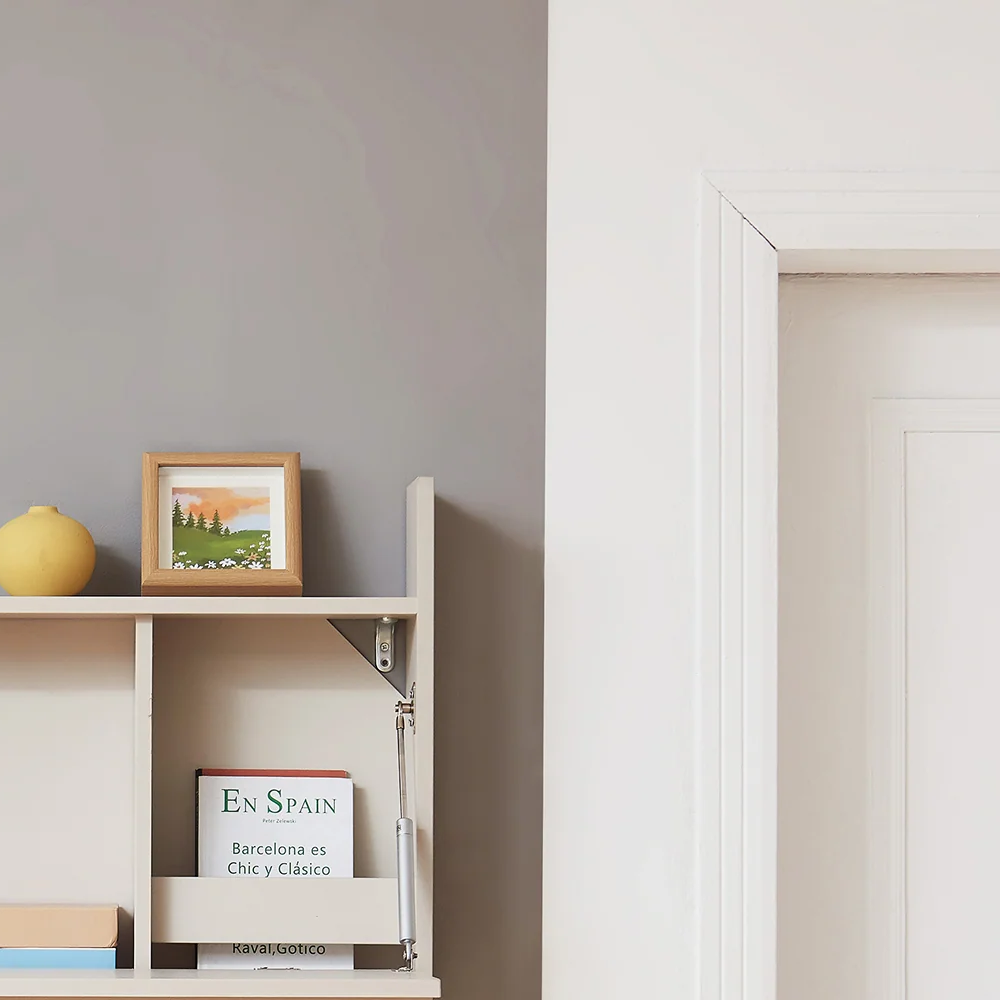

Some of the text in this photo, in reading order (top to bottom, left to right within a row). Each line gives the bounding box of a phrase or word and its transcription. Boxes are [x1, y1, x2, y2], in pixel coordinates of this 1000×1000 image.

[232, 842, 327, 856] Barcelona es
[227, 860, 331, 878] Chic y Clásico
